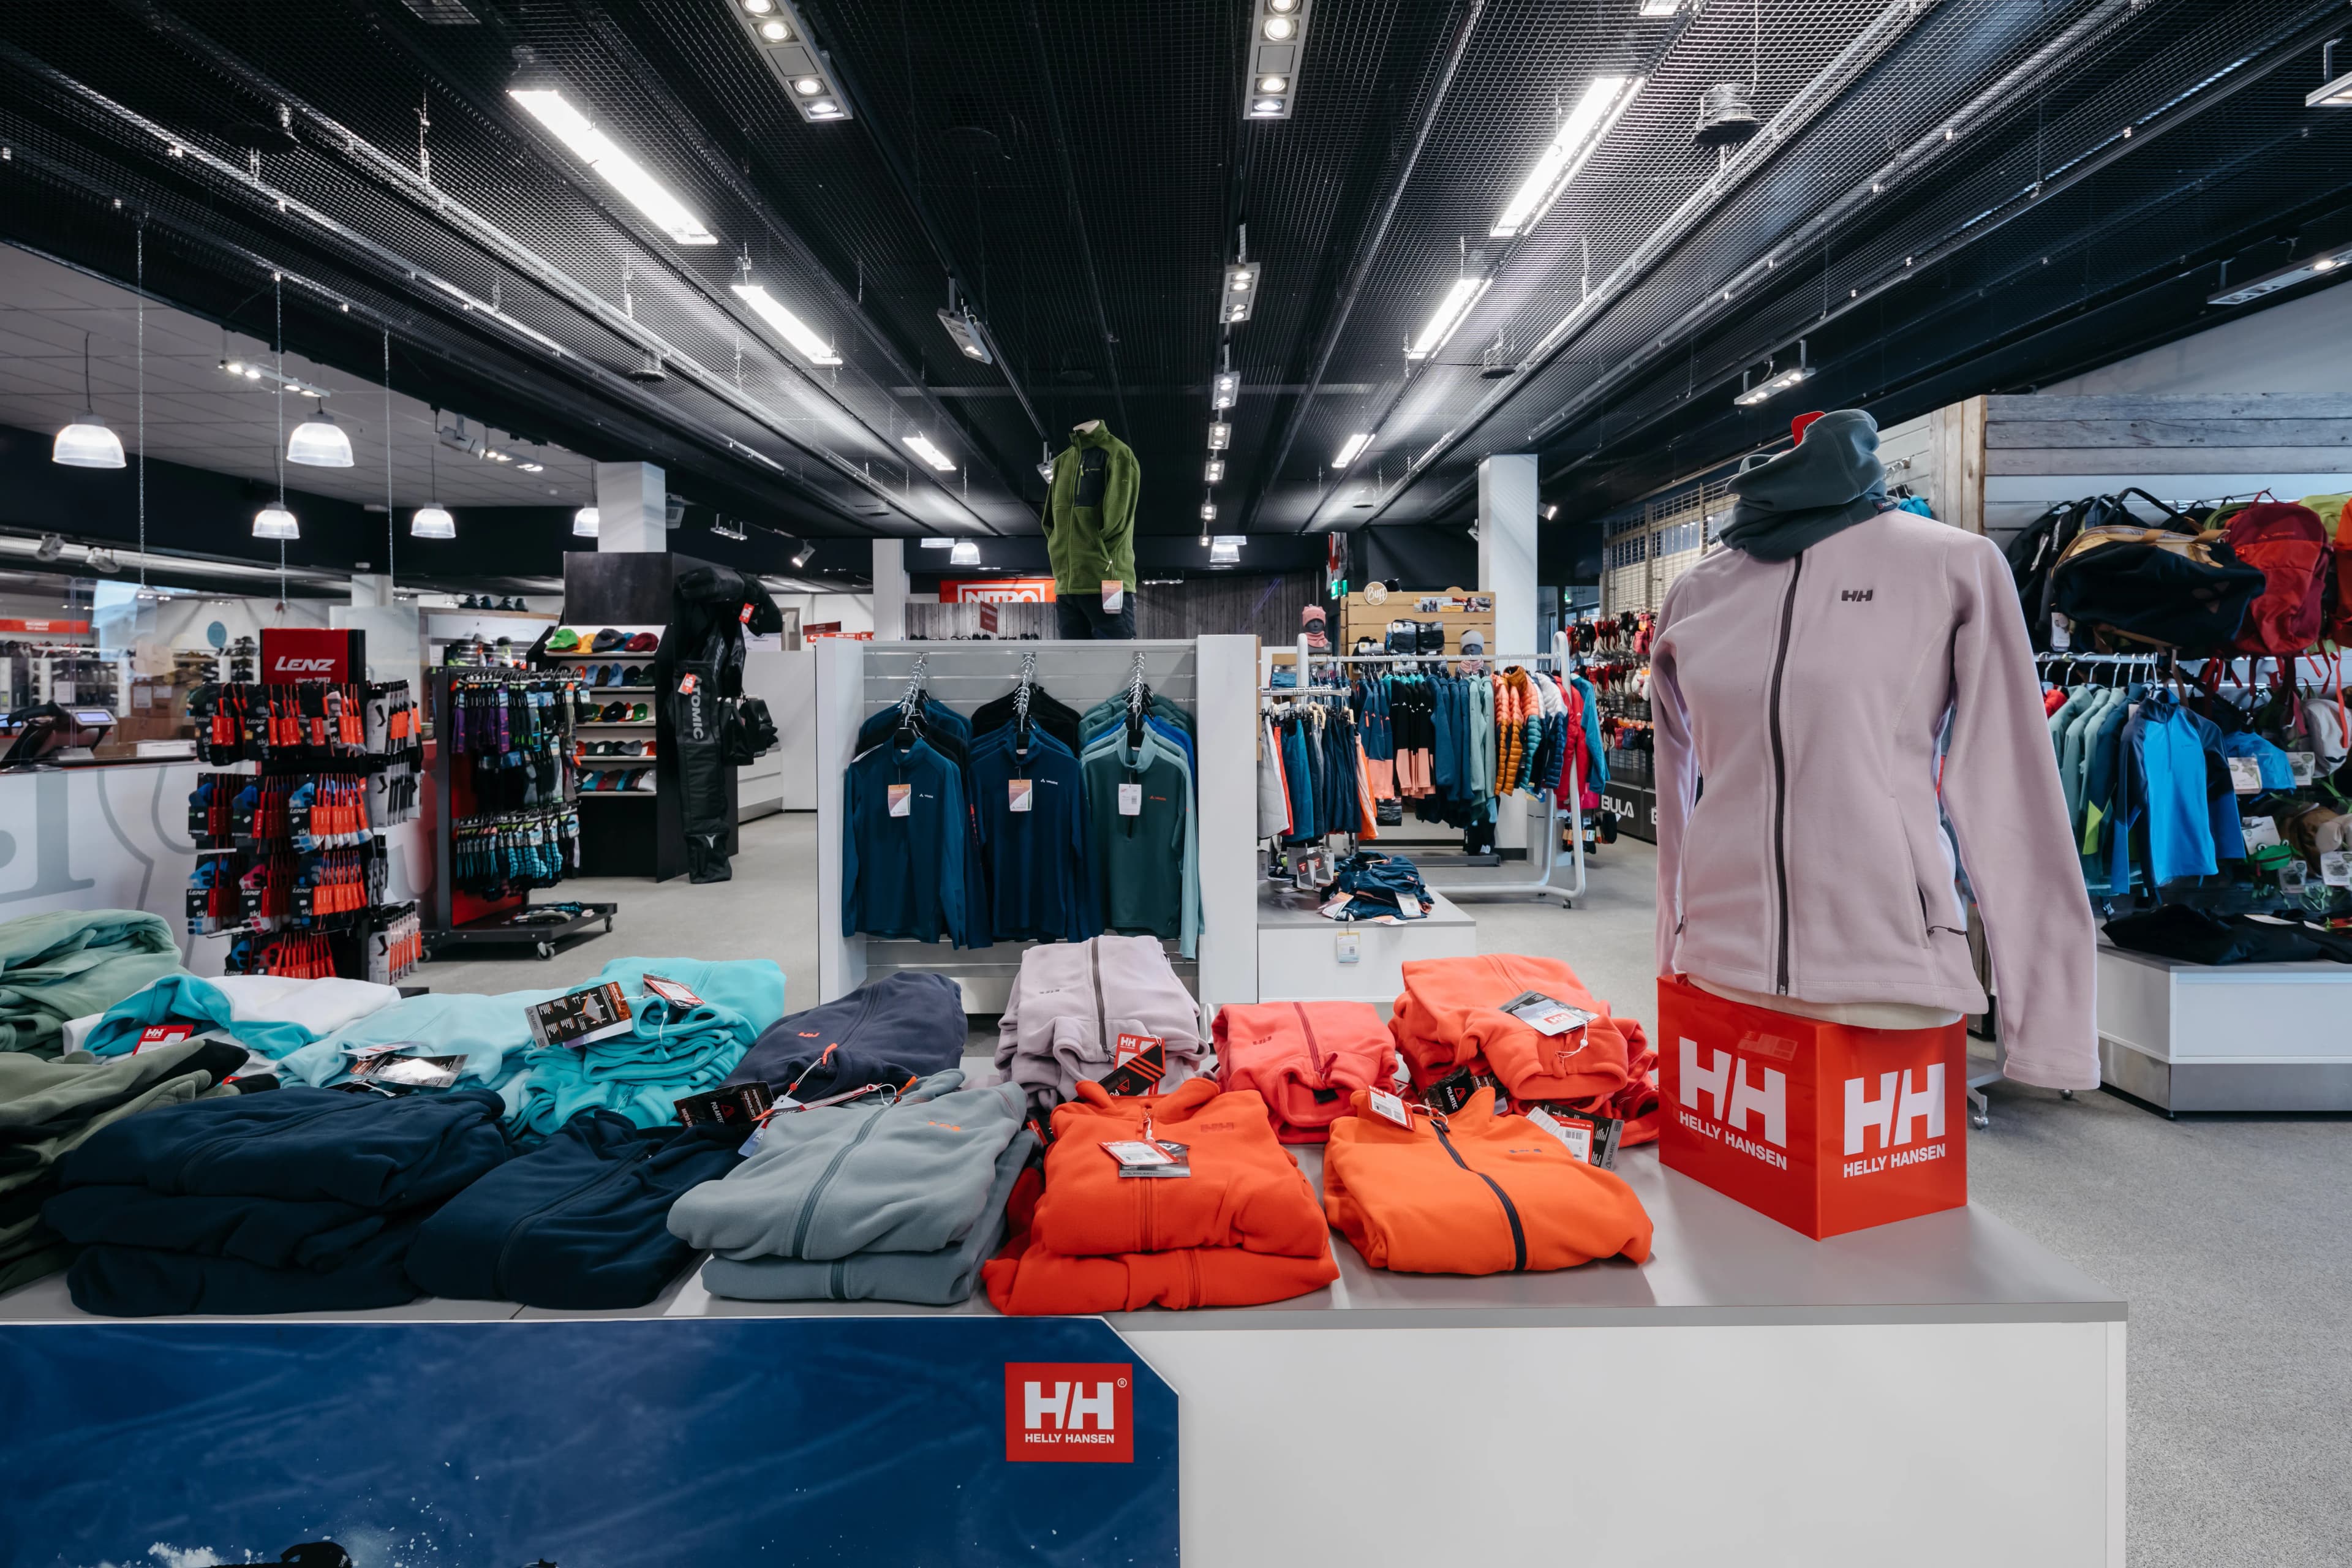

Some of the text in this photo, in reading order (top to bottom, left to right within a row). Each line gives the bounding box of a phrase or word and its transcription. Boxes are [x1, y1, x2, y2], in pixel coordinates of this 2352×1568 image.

[1841, 589, 1873, 601] HH
[274, 656, 336, 671] LENZ
[1601, 794, 1634, 818] BULA
[1120, 1036, 1136, 1047] HH
[1446, 1085, 1458, 1110] POLARTEC
[1679, 1036, 1787, 1149] HH
[1844, 1063, 1945, 1156] HH
[1679, 1110, 1787, 1170] HELLY HANSEN
[1844, 1143, 1946, 1178] HELLY HANSEN
[1024, 1381, 1114, 1430] HH
[1025, 1433, 1115, 1444] HELLY HANSEN
